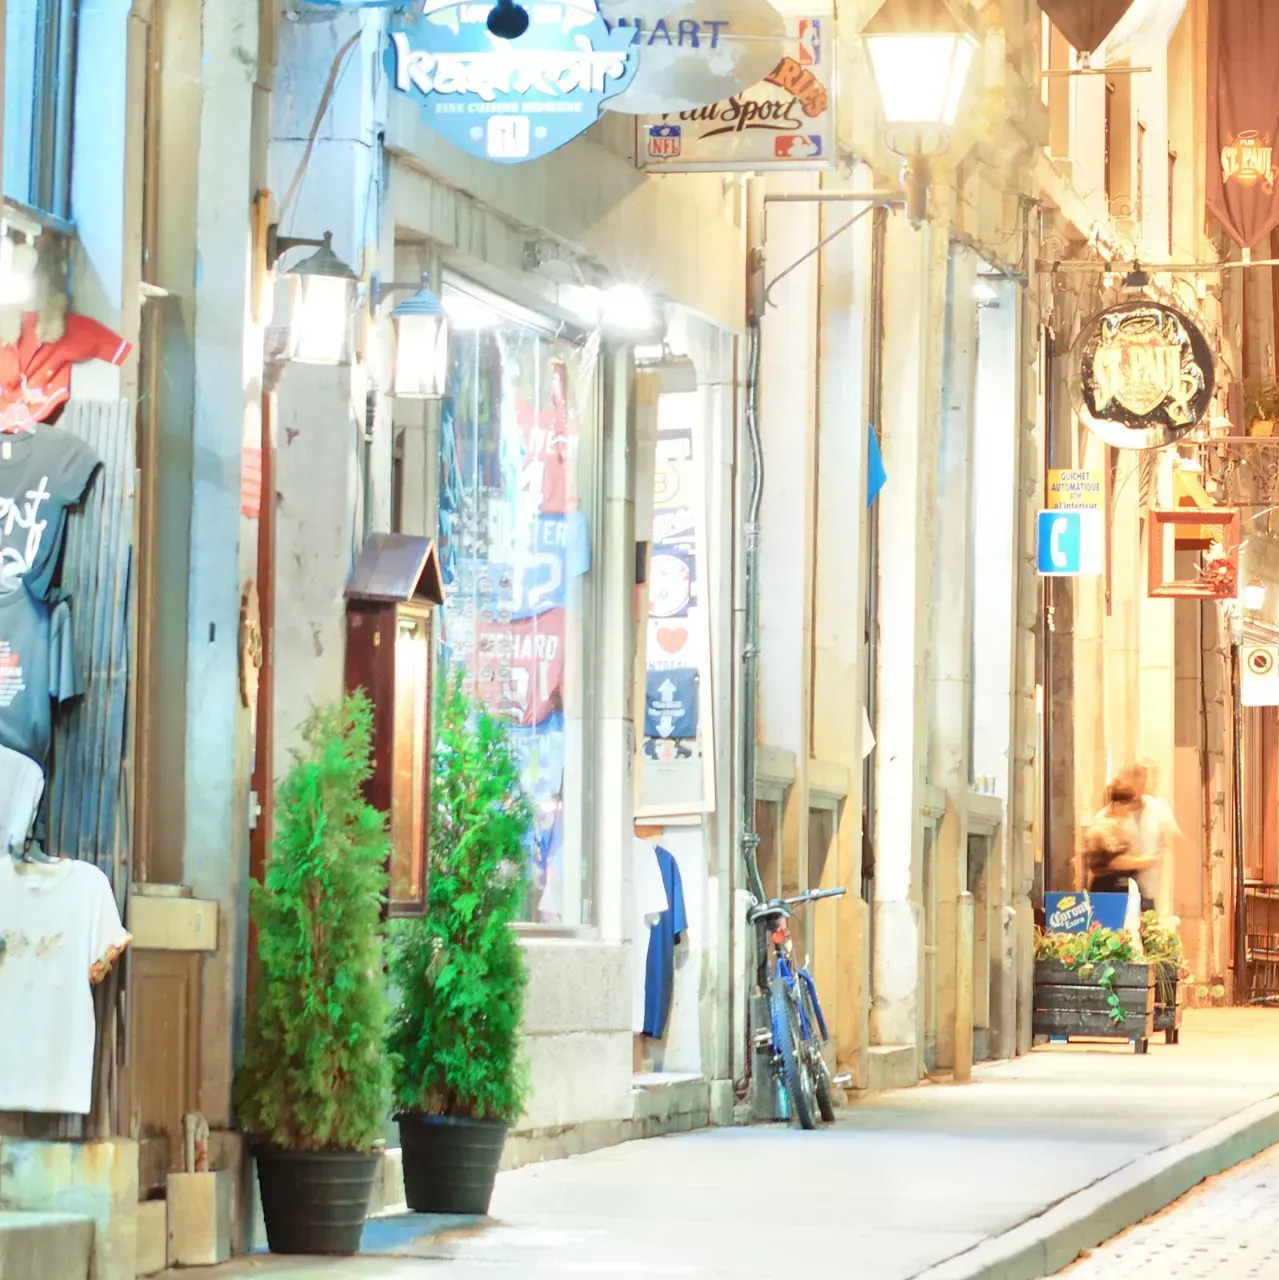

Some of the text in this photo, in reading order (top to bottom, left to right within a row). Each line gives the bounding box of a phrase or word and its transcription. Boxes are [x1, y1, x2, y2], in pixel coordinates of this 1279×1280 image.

[435, 102, 465, 114] FINE
[721, 91, 802, 132] Sport
[652, 139, 680, 154] NFL
[1241, 147, 1273, 187] PAUL
[1060, 472, 1090, 481] GUICHET
[1051, 483, 1100, 492] AUTOMATIQUE
